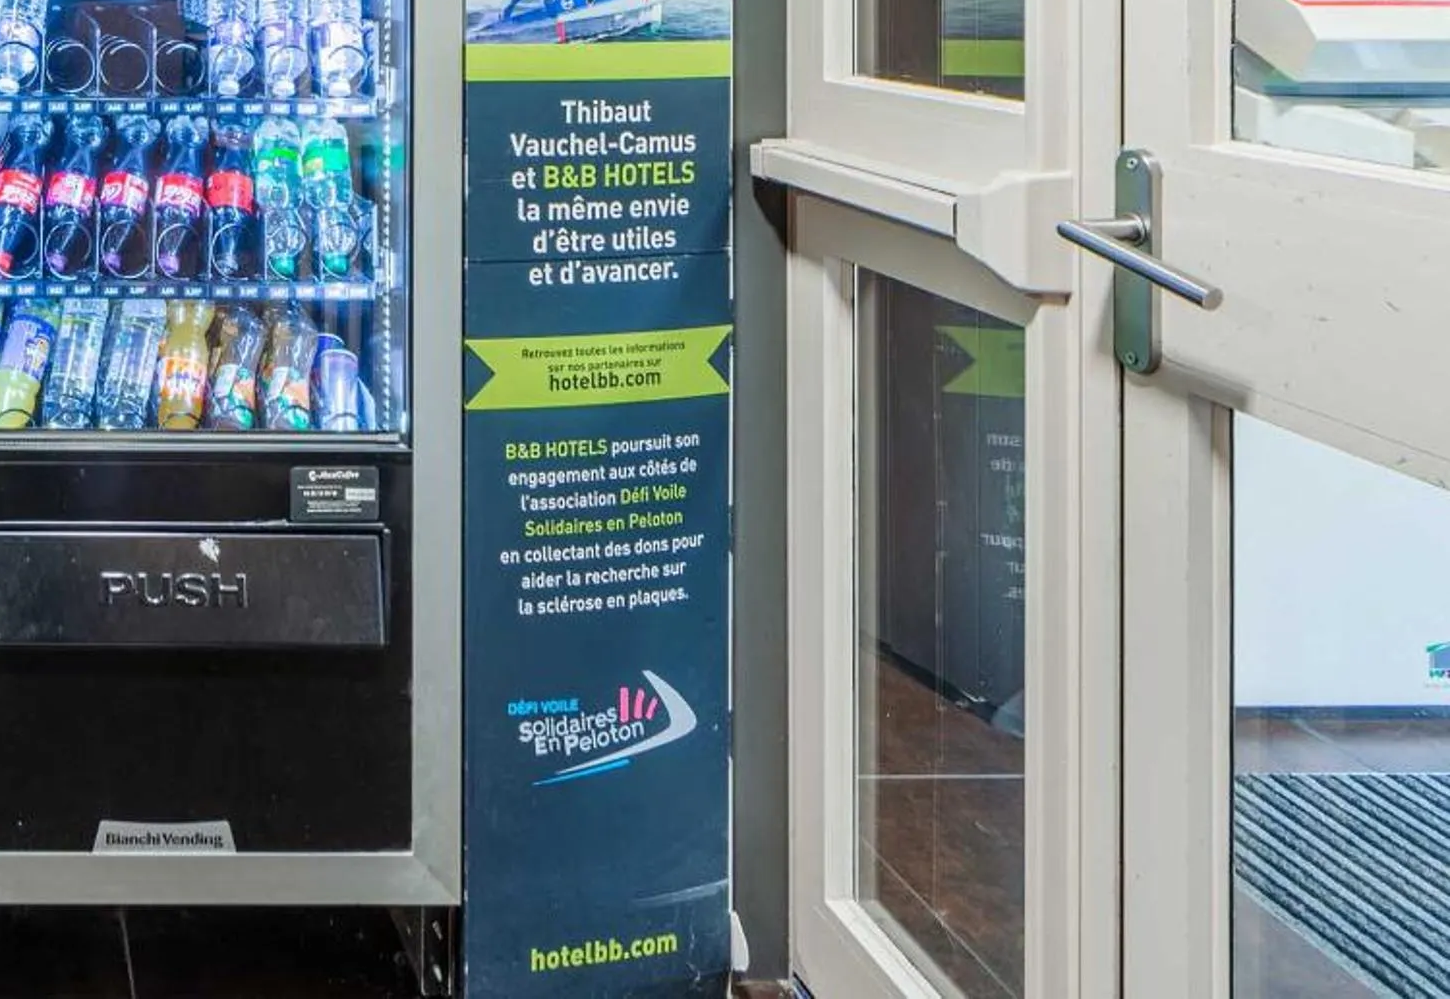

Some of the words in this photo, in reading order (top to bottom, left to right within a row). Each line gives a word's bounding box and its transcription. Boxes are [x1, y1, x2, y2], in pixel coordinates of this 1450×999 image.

[560, 99, 652, 125] Thibaut
[509, 132, 697, 157] Vauchel-Camus
[511, 167, 536, 189] et
[542, 165, 597, 189] B&B
[604, 161, 695, 187] HOTELS
[517, 198, 540, 222] la
[547, 195, 623, 220] même
[629, 193, 690, 217] envie
[532, 229, 605, 254] d'être
[612, 226, 677, 250] utiles
[528, 263, 554, 285] et
[559, 260, 679, 284] d'avancer.
[522, 347, 573, 358] Retrouvez
[575, 347, 607, 357] toutes
[608, 346, 624, 355] les
[626, 341, 686, 354] informations
[547, 365, 564, 373] sur
[568, 363, 586, 372] nos
[588, 358, 645, 373] partenaires
[646, 358, 662, 367] sur
[550, 370, 662, 392] hotelbb.com
[505, 443, 541, 460] B&B
[546, 440, 609, 458] HOTELS
[611, 435, 671, 457] poursuit
[674, 433, 700, 447] son
[508, 466, 606, 487] engagement
[610, 465, 636, 480] aux
[639, 459, 678, 476] côtés
[680, 456, 697, 473] de
[520, 490, 617, 512] l'association
[619, 486, 650, 505] Défi
[652, 483, 687, 501] Voile
[524, 516, 603, 537] Solidaires
[607, 516, 626, 531] en
[629, 510, 683, 529] Peloton
[500, 548, 521, 565] en
[524, 544, 600, 563] collectant
[604, 538, 632, 557] des
[634, 537, 669, 553] dons
[671, 532, 705, 553] pour
[521, 570, 561, 589] aider
[566, 569, 581, 585] la
[584, 564, 660, 583] recherche
[662, 561, 687, 575] sur
[100, 571, 248, 609] PUSH
[518, 599, 533, 615] la
[537, 592, 603, 613] sclérose
[606, 593, 626, 608] en
[629, 588, 689, 610] plaques.
[540, 698, 579, 713] VOILE
[517, 706, 617, 743] Solidaires
[535, 735, 561, 756] En
[563, 720, 645, 756] Peloton
[105, 831, 161, 846] Bianchi
[162, 832, 223, 848] Vending
[529, 932, 679, 974] hotelbb.com
